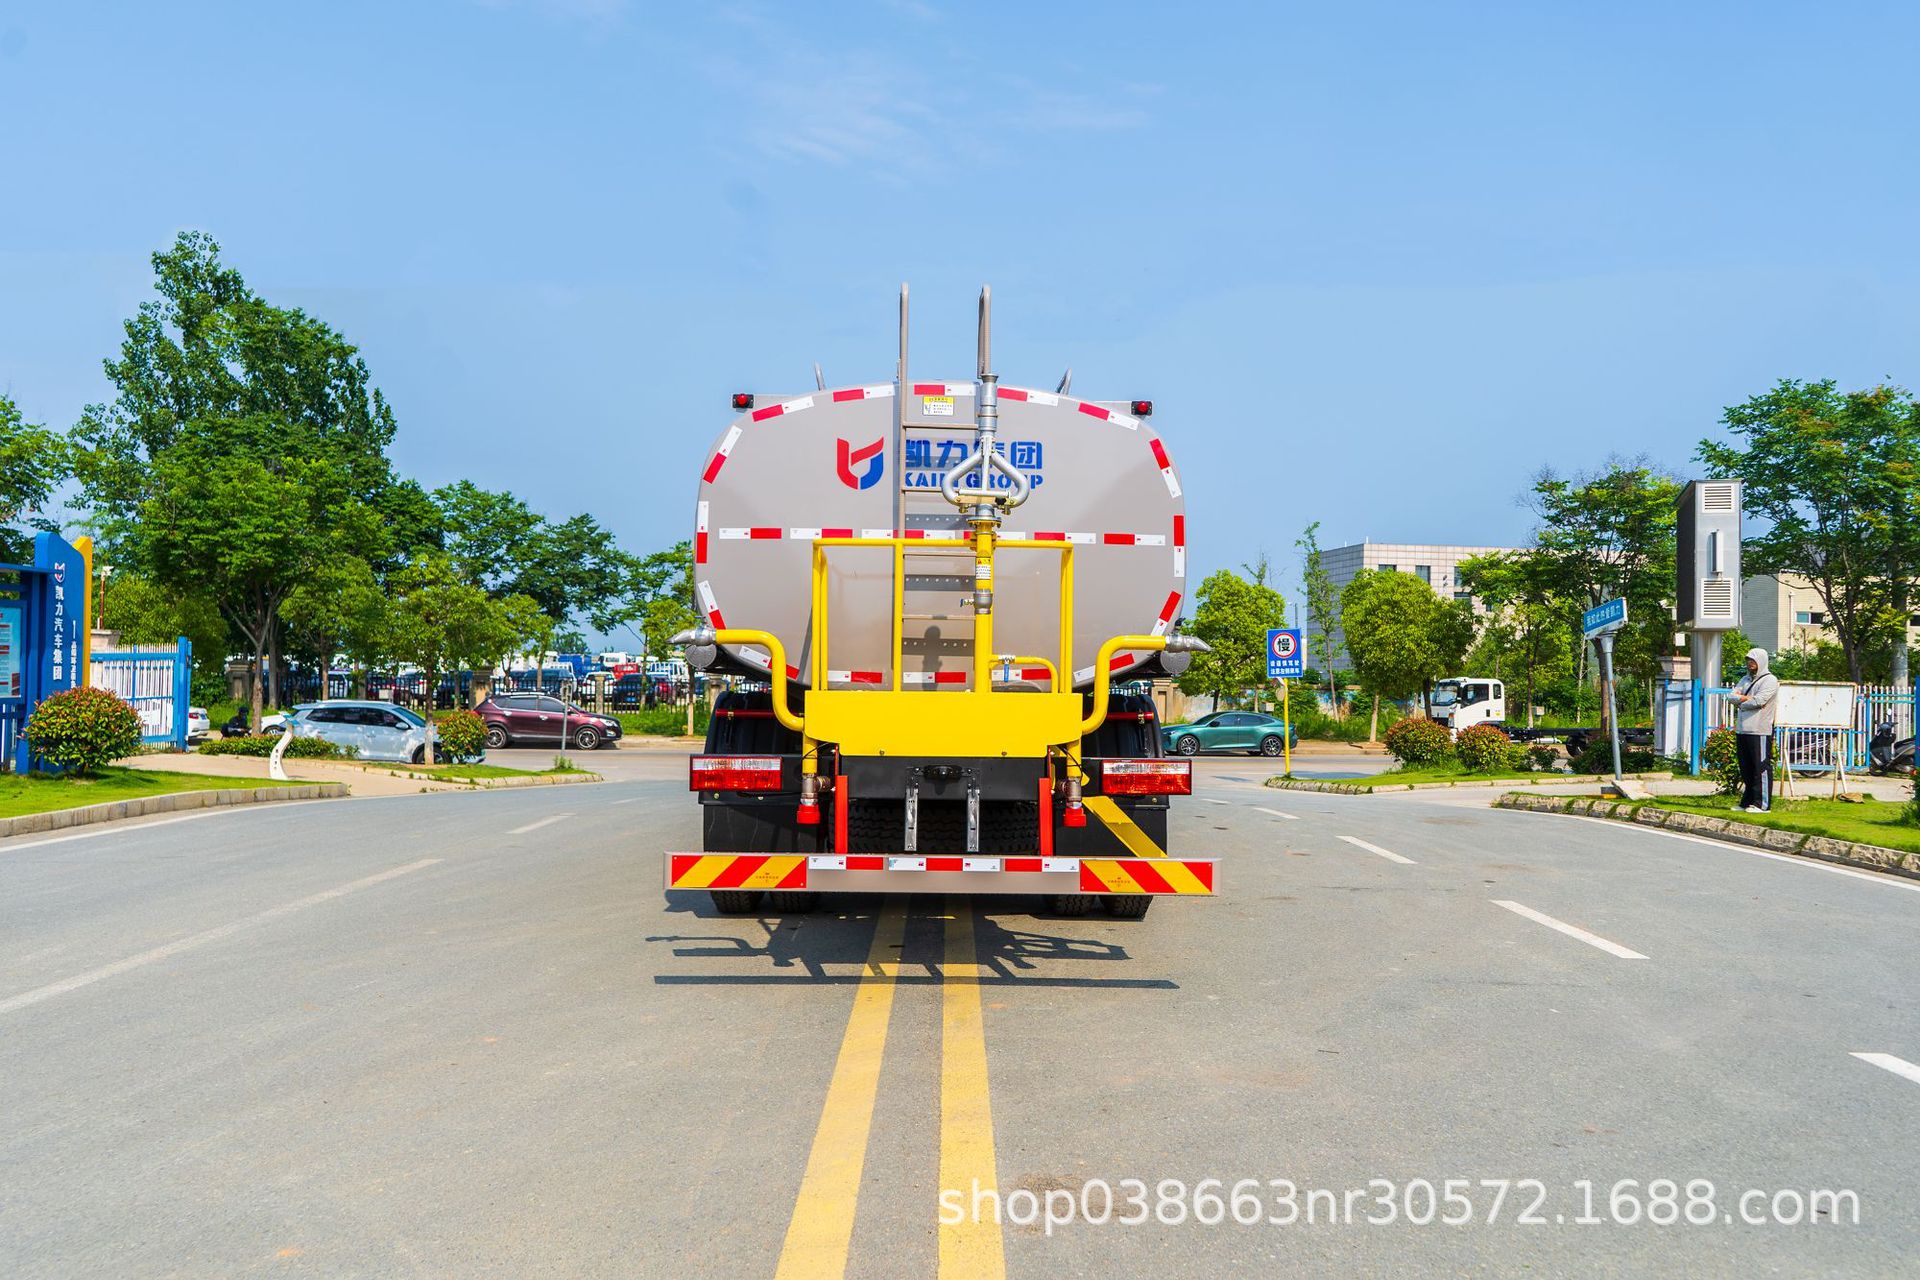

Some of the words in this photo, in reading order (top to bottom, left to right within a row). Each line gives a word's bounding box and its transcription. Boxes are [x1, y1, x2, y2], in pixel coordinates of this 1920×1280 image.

[966, 473, 1044, 489] GROP
[53, 587, 65, 680] 凯力汽车集团
[1277, 638, 1290, 651] 慢
